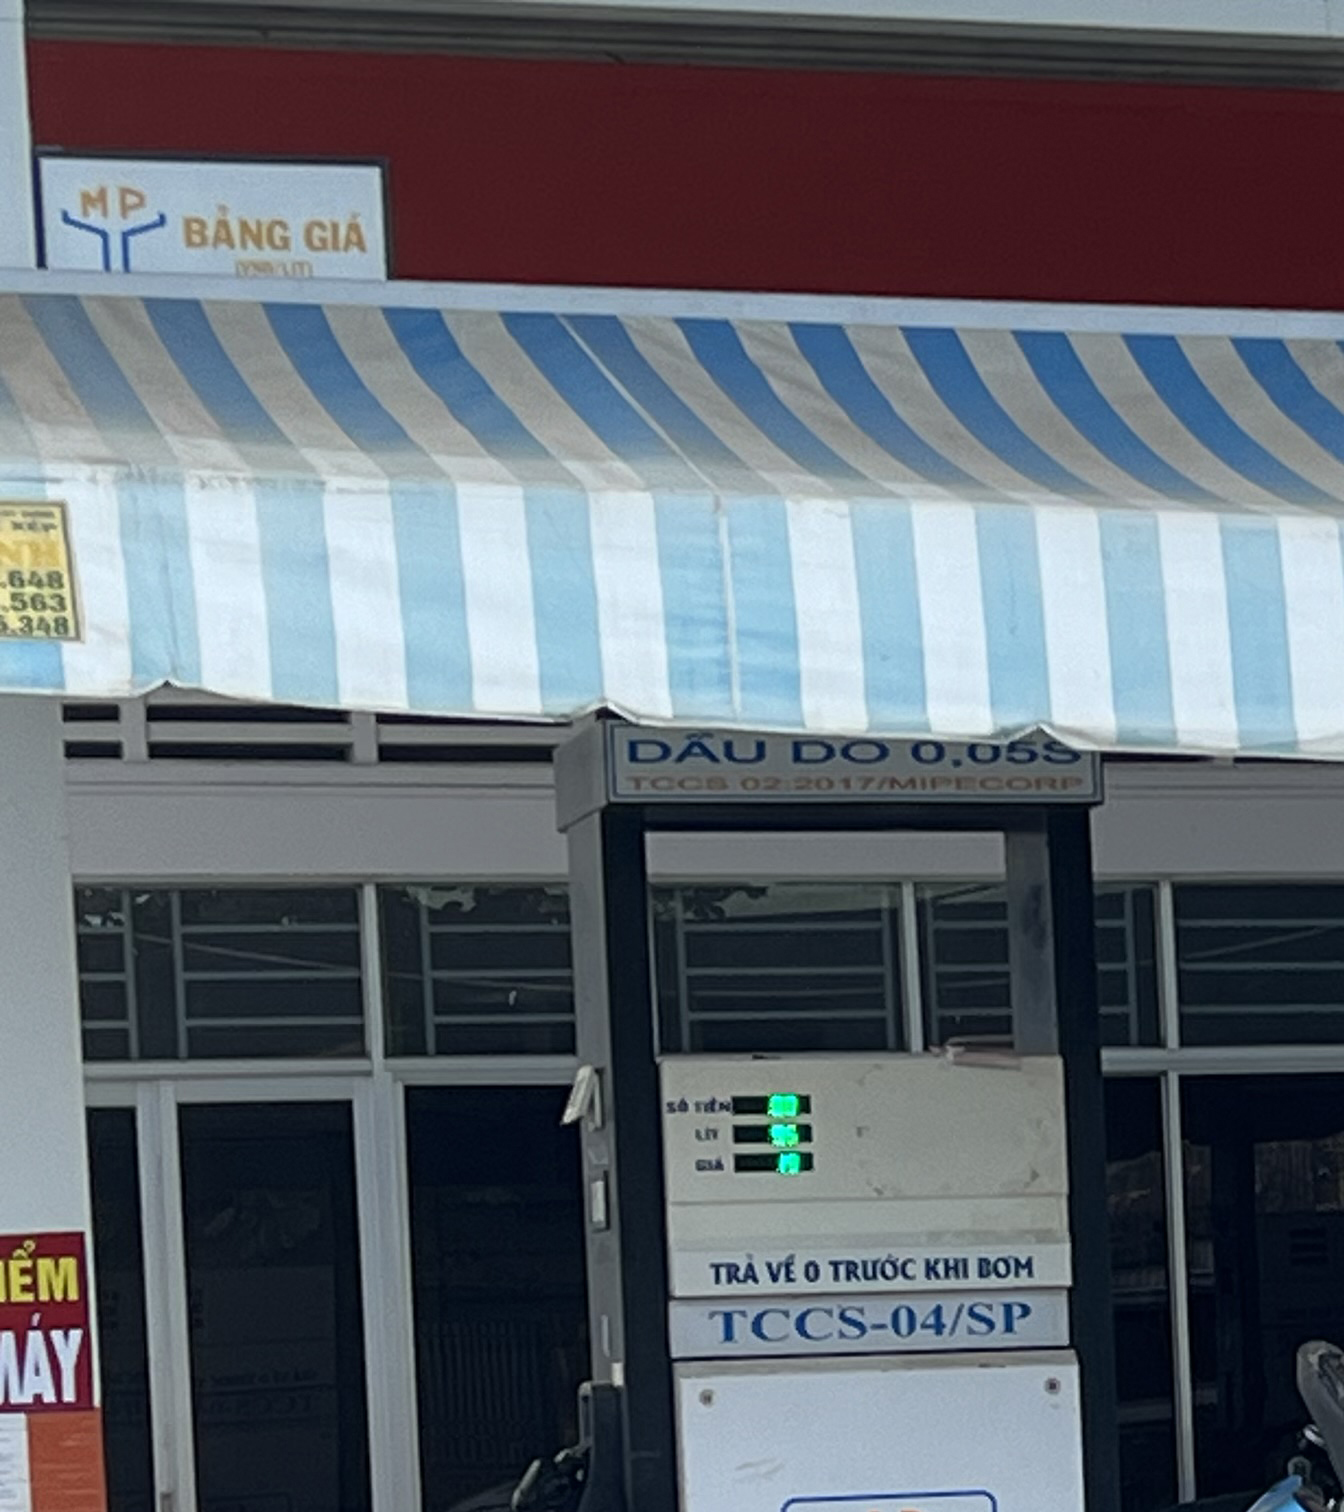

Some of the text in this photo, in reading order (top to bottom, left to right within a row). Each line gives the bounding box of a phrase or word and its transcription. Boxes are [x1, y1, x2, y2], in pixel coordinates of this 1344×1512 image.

[182, 204, 367, 254] BẢNG GIÁ
[791, 739, 891, 764] DO
[709, 1252, 759, 1285] TRẢ
[828, 1252, 916, 1283] TRƯỚC
[924, 1257, 969, 1281] KHI
[977, 1255, 1034, 1279] BƠM
[708, 1301, 1033, 1344] TCCS-04/SP
